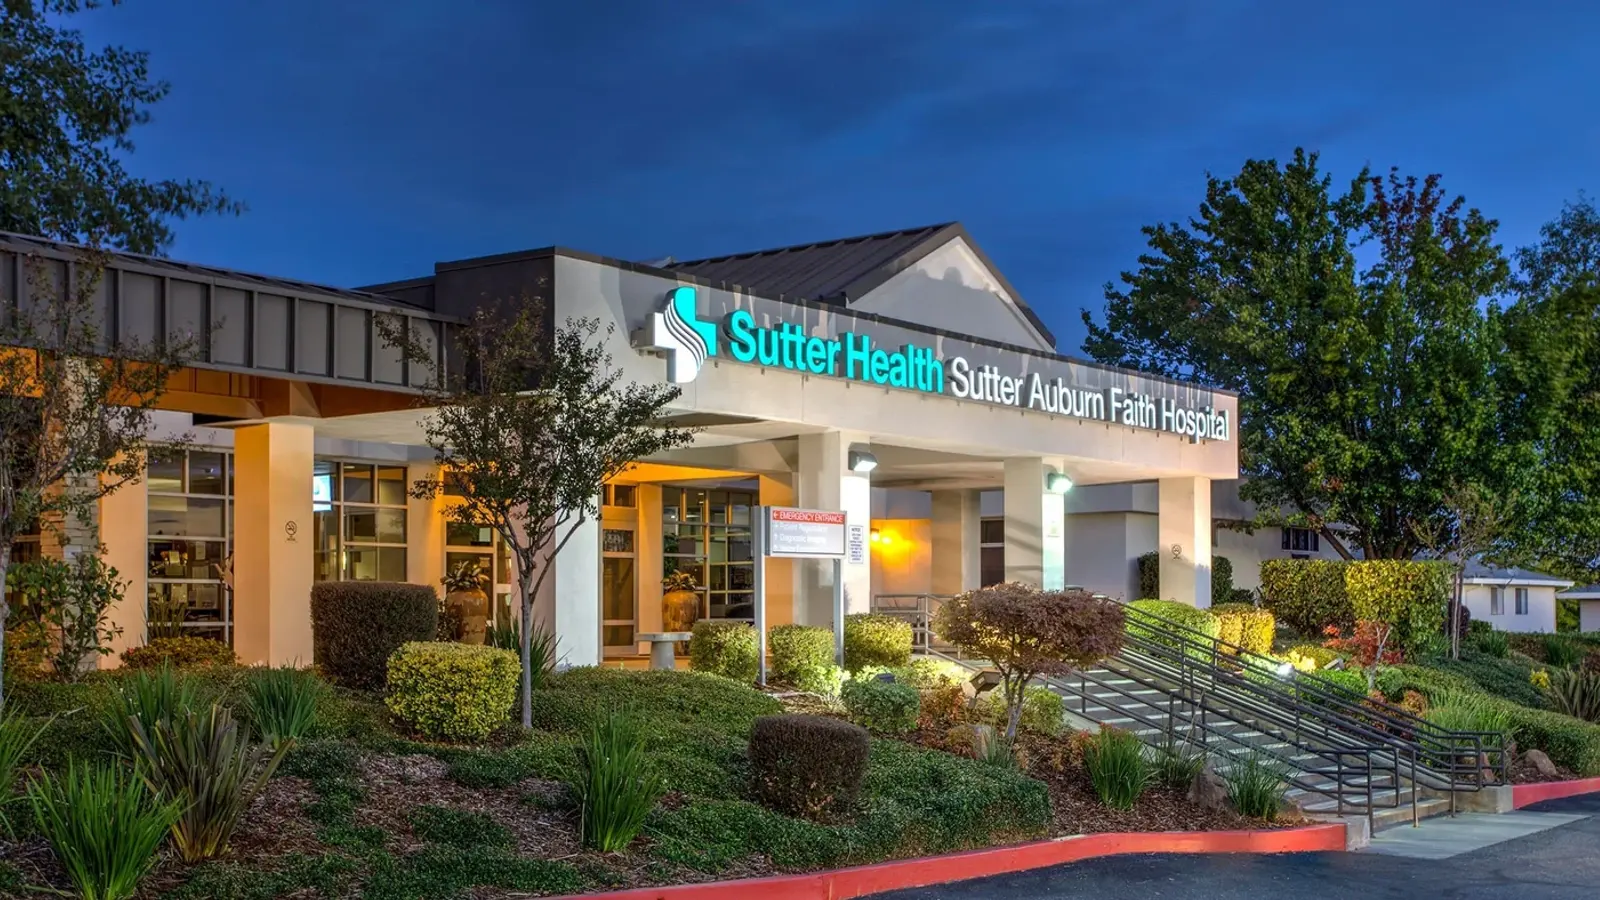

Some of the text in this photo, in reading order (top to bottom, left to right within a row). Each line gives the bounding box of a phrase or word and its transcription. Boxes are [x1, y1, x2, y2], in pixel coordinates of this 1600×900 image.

[730, 310, 1230, 444] Sutter Health Sutter Auburn Faith Hospital
[780, 511, 844, 523] EMERGENCY ENTRANCE
